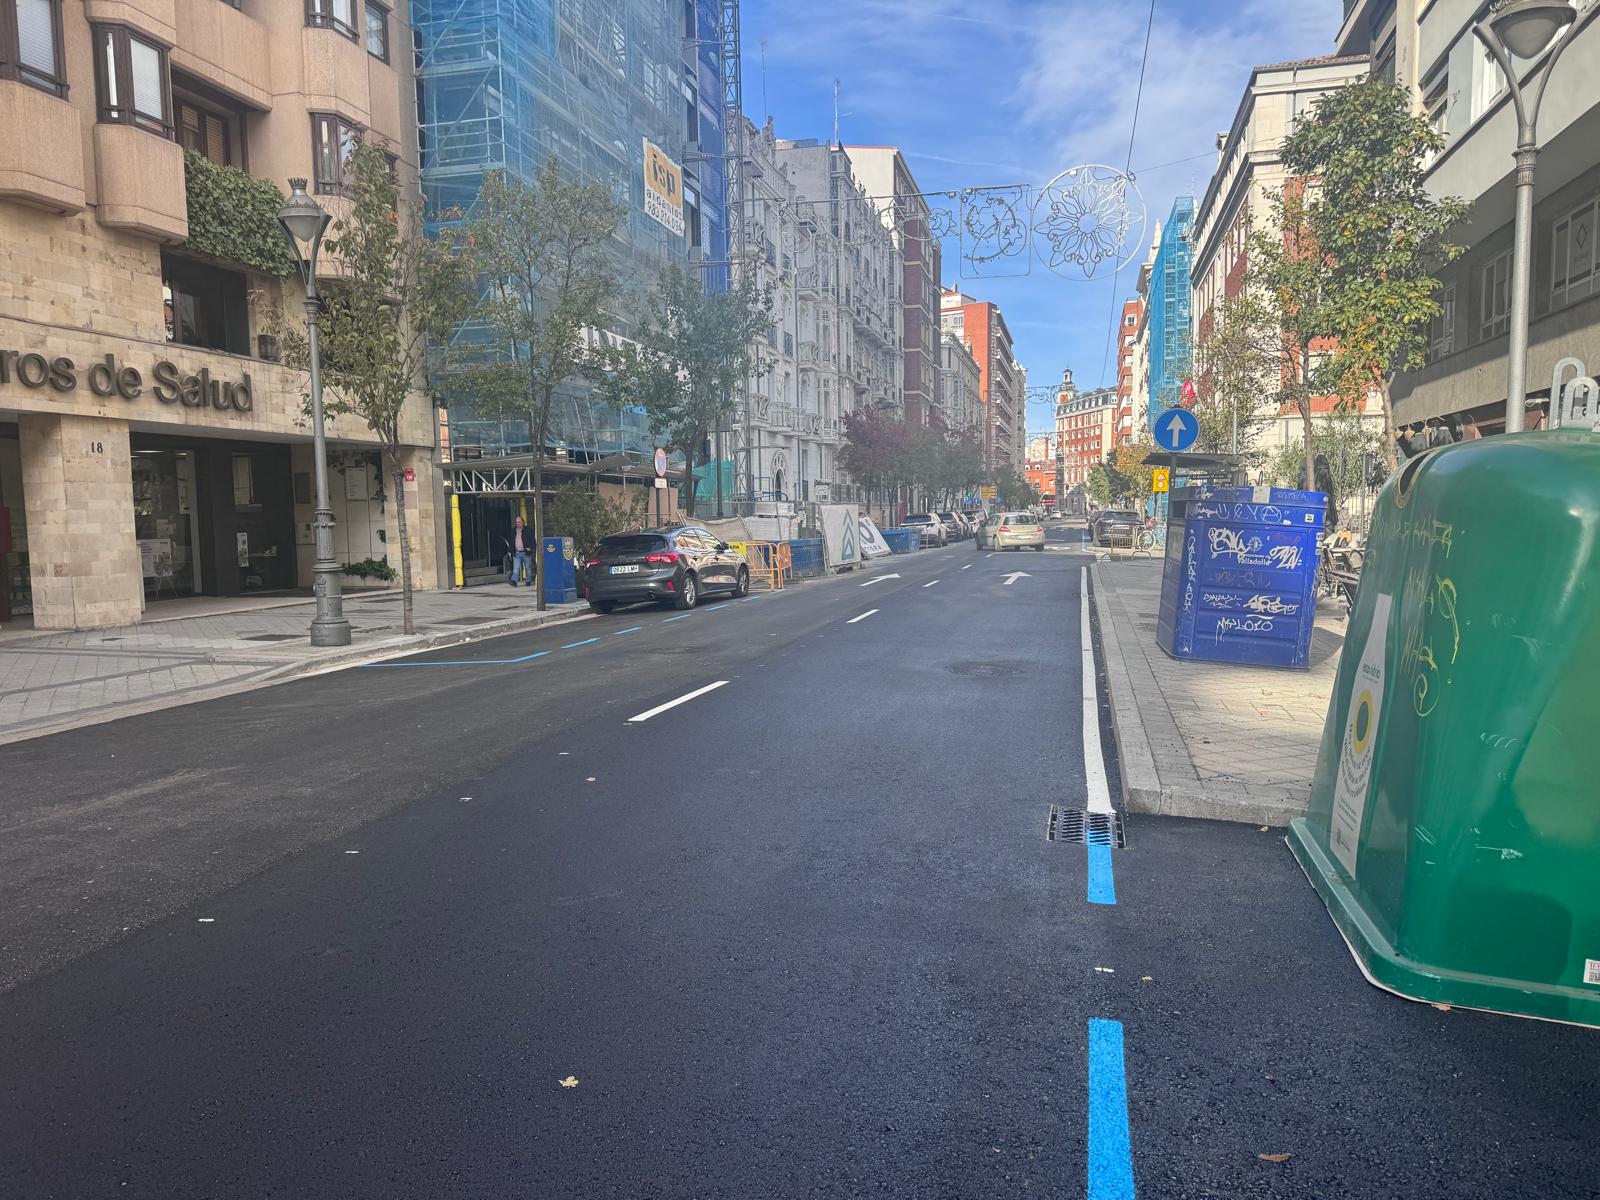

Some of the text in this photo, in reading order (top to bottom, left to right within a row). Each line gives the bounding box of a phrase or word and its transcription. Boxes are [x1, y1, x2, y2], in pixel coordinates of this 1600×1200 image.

[88, 353, 143, 400] de
[152, 360, 254, 412] Salud
[90, 441, 104, 454] 18
